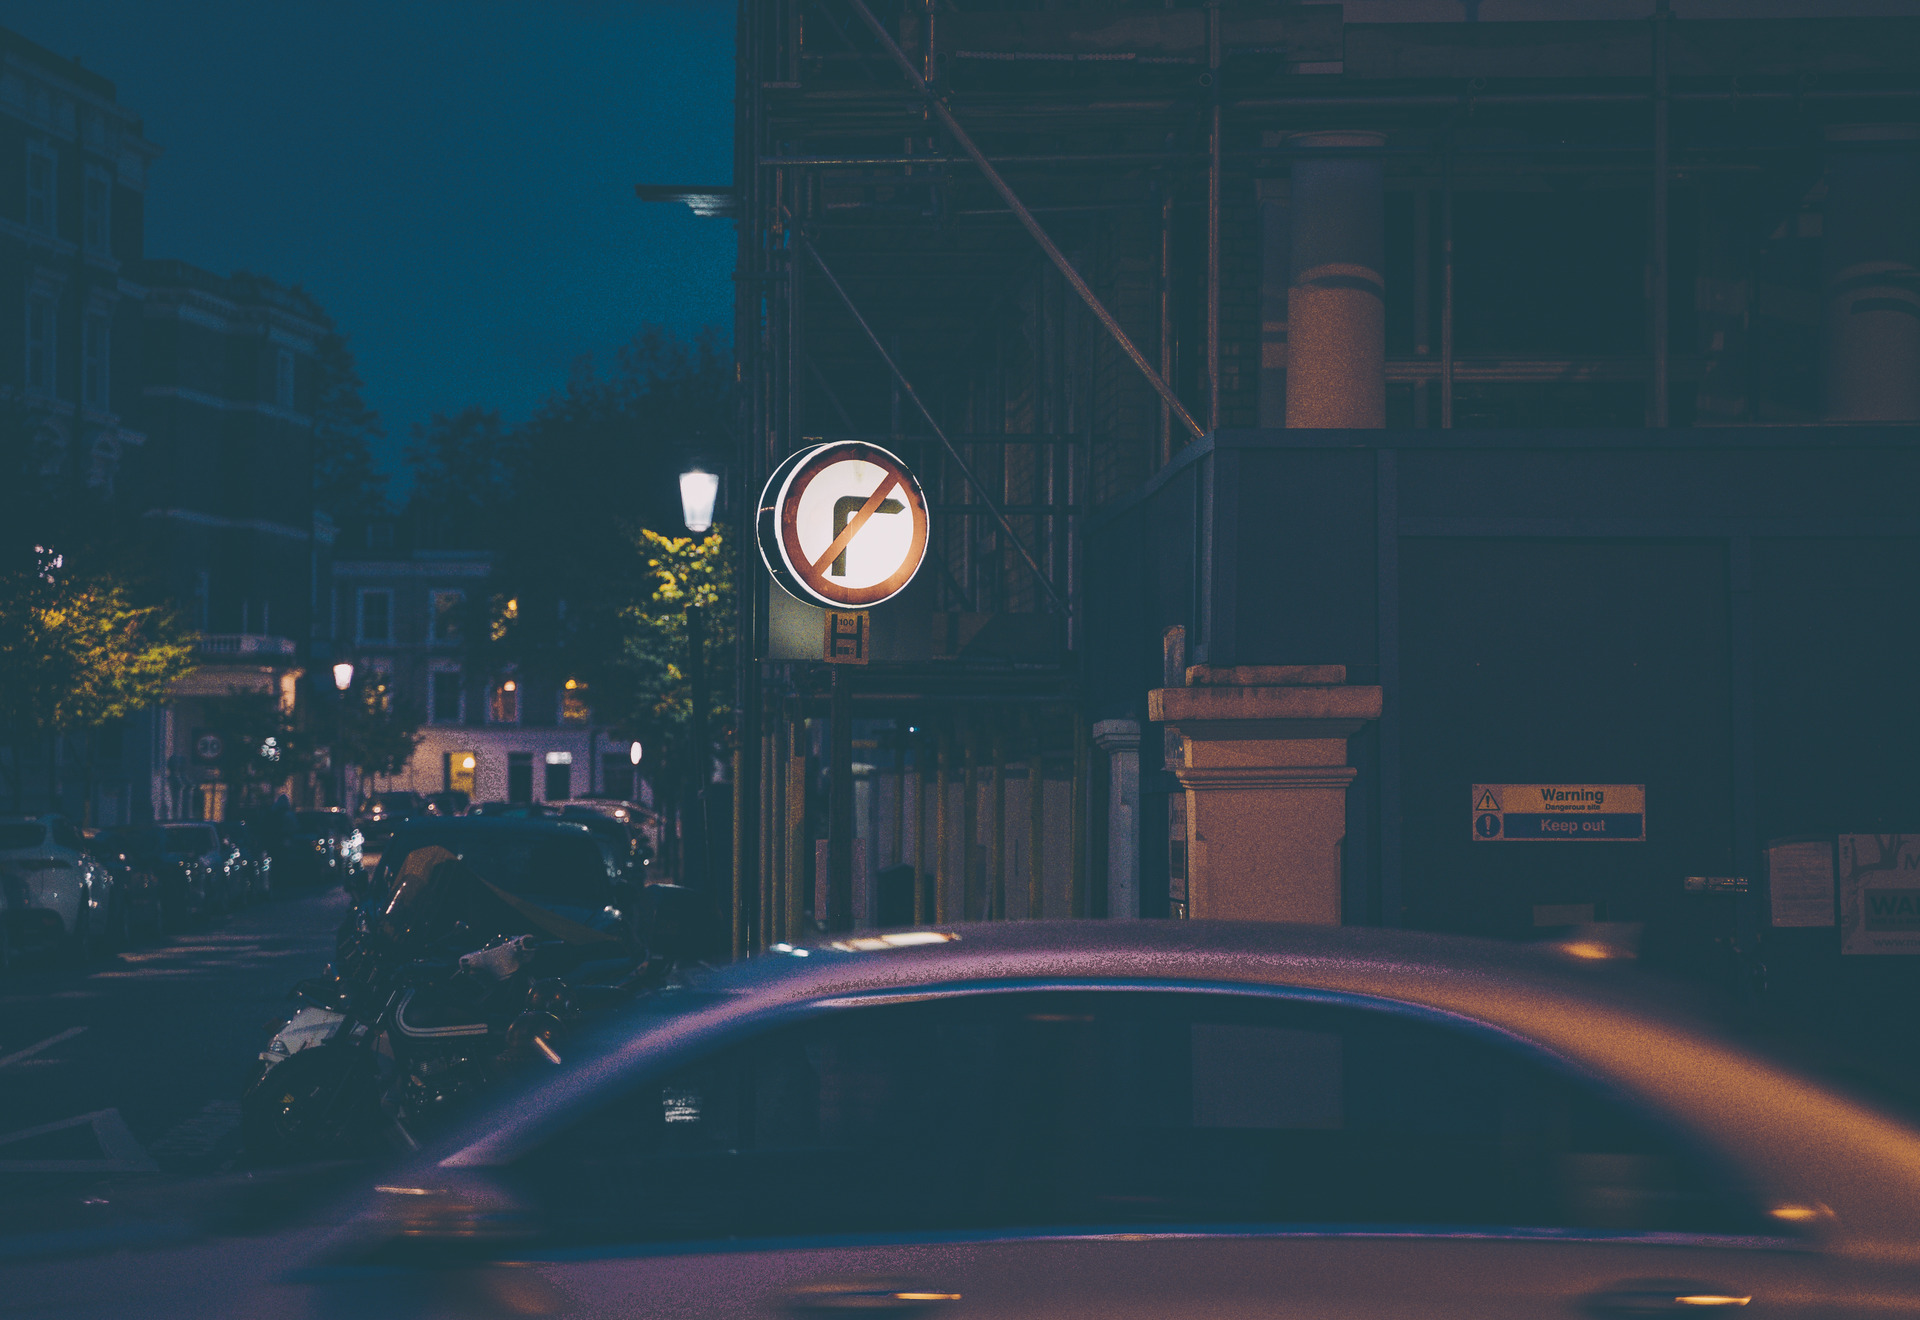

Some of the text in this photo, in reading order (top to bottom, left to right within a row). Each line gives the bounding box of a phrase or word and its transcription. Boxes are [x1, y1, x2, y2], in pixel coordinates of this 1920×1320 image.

[840, 618, 854, 627] 100
[1541, 788, 1604, 804] Warning
[1541, 819, 1606, 834] Keep out
[1871, 897, 1920, 915] WA
